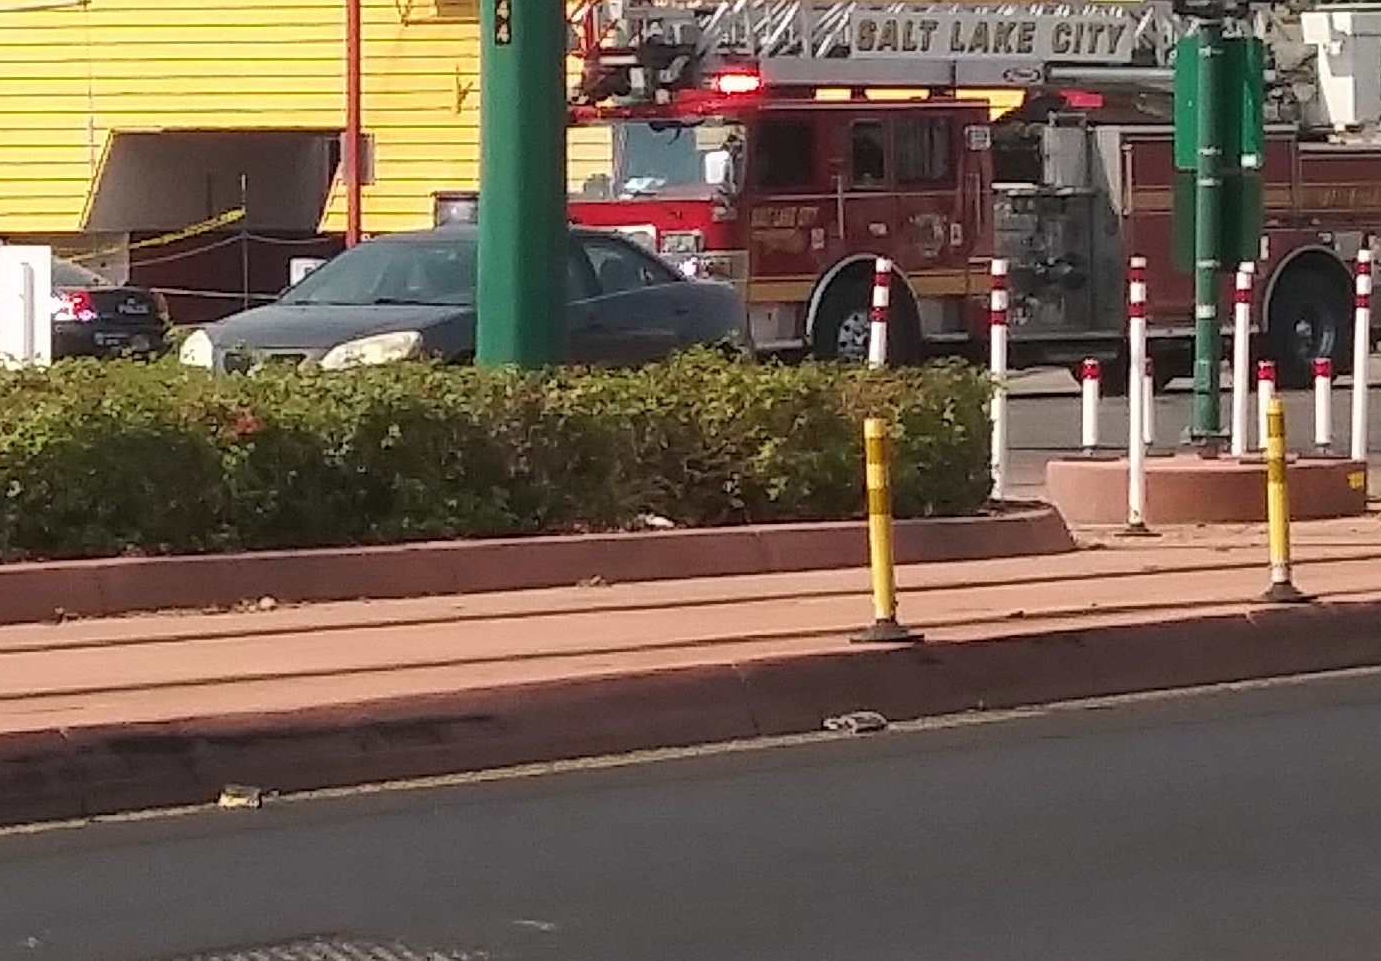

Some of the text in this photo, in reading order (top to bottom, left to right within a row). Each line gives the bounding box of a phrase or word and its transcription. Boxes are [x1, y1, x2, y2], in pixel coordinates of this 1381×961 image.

[857, 19, 1127, 55] SALT LAKE CITY
